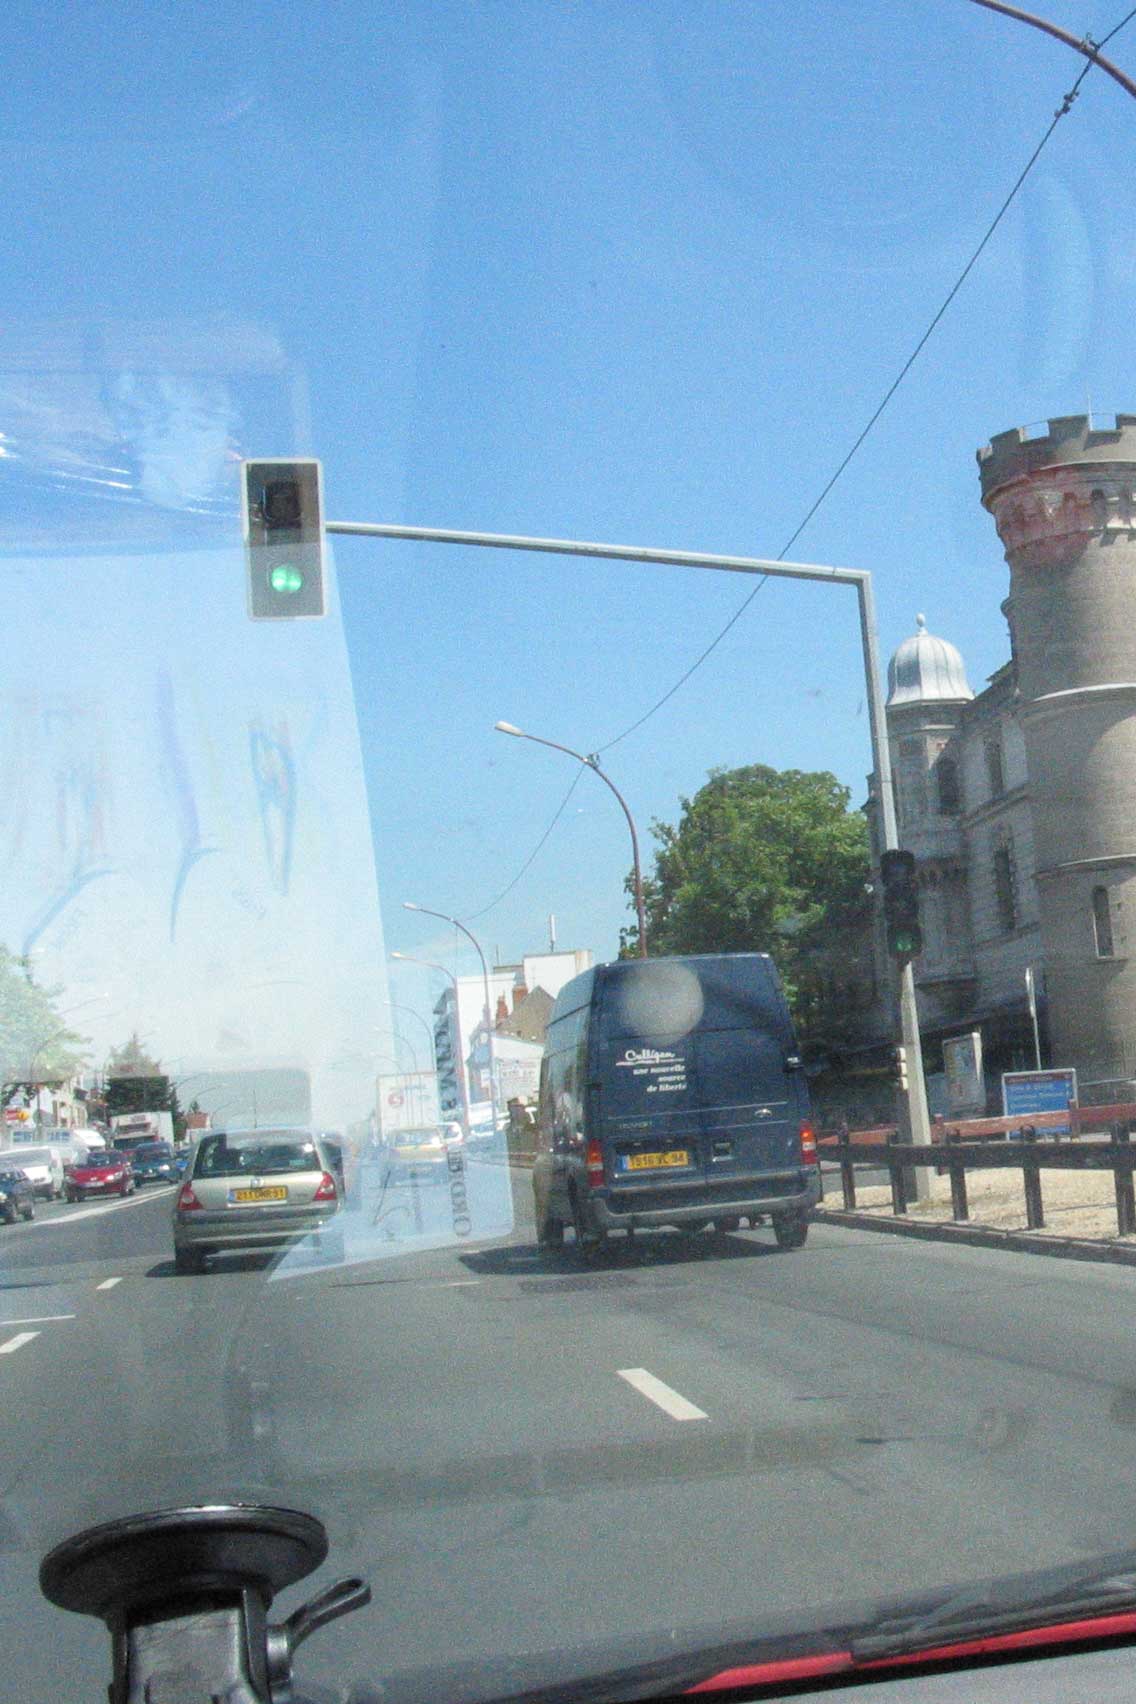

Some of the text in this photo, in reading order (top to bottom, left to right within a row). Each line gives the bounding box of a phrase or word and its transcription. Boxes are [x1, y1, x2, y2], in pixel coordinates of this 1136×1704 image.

[625, 1048, 676, 1064] Culligan
[650, 1064, 686, 1074] nouvelle
[657, 1074, 687, 1082] source
[646, 1084, 658, 1093] de
